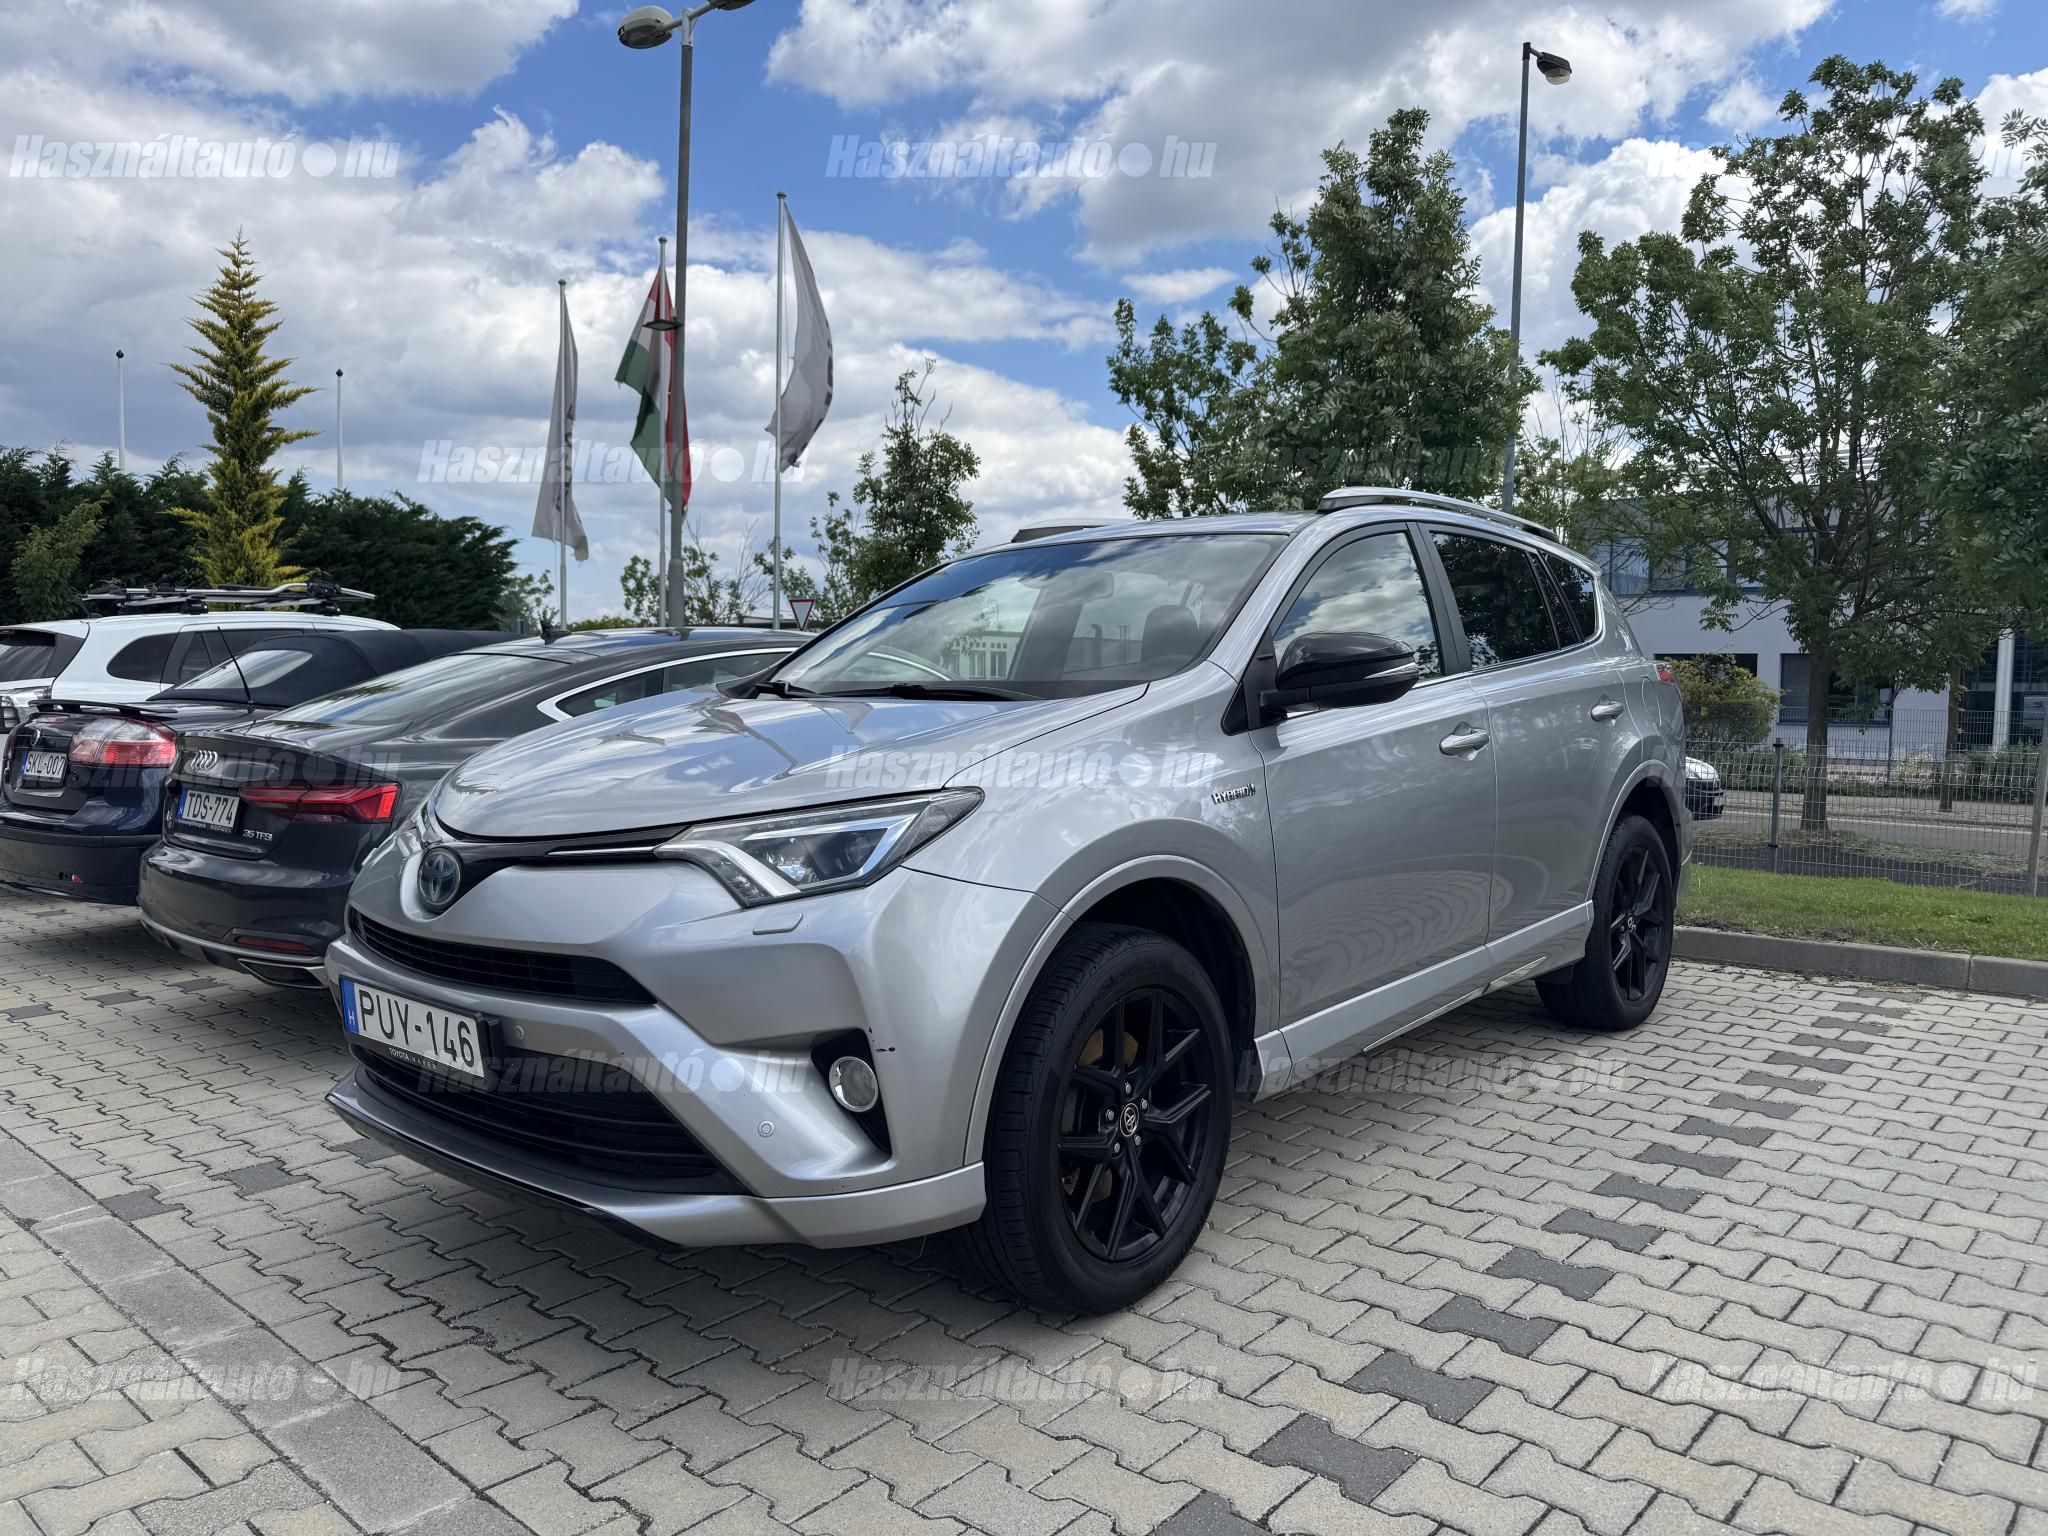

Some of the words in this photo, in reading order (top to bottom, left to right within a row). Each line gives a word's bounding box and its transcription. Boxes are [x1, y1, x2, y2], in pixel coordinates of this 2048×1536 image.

[26, 753, 66, 775] SKL-007
[1211, 785, 1253, 805] HYBRID
[186, 792, 236, 825] TDS-774
[243, 829, 255, 839] 35
[358, 988, 475, 1068] PUY-146
